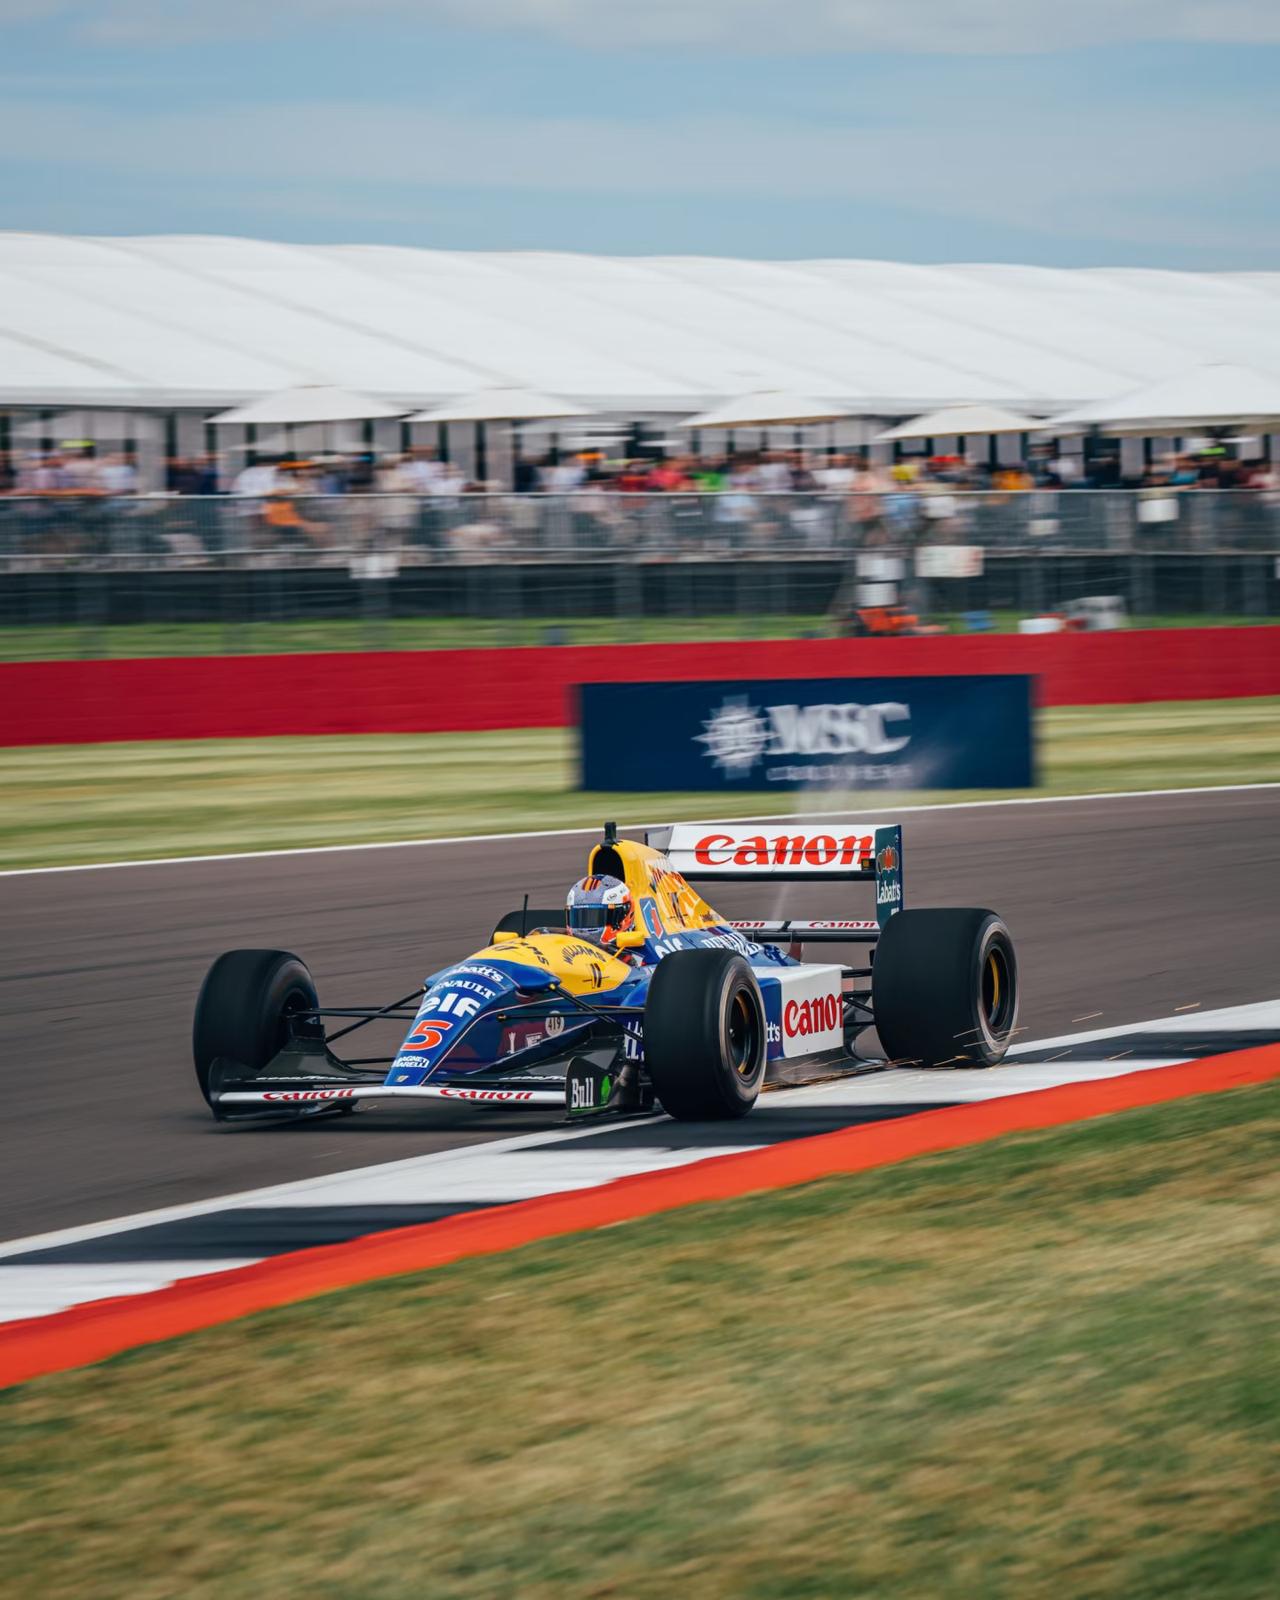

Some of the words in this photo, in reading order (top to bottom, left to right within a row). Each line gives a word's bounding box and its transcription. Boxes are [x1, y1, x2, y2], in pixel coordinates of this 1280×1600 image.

[694, 834, 874, 866] Canon
[808, 920, 876, 928] Canon
[416, 993, 481, 1018] elf
[400, 1020, 454, 1051] 5
[262, 1088, 355, 1101] Canon
[439, 1088, 534, 1101] Canon
[571, 1077, 595, 1109] Bull
